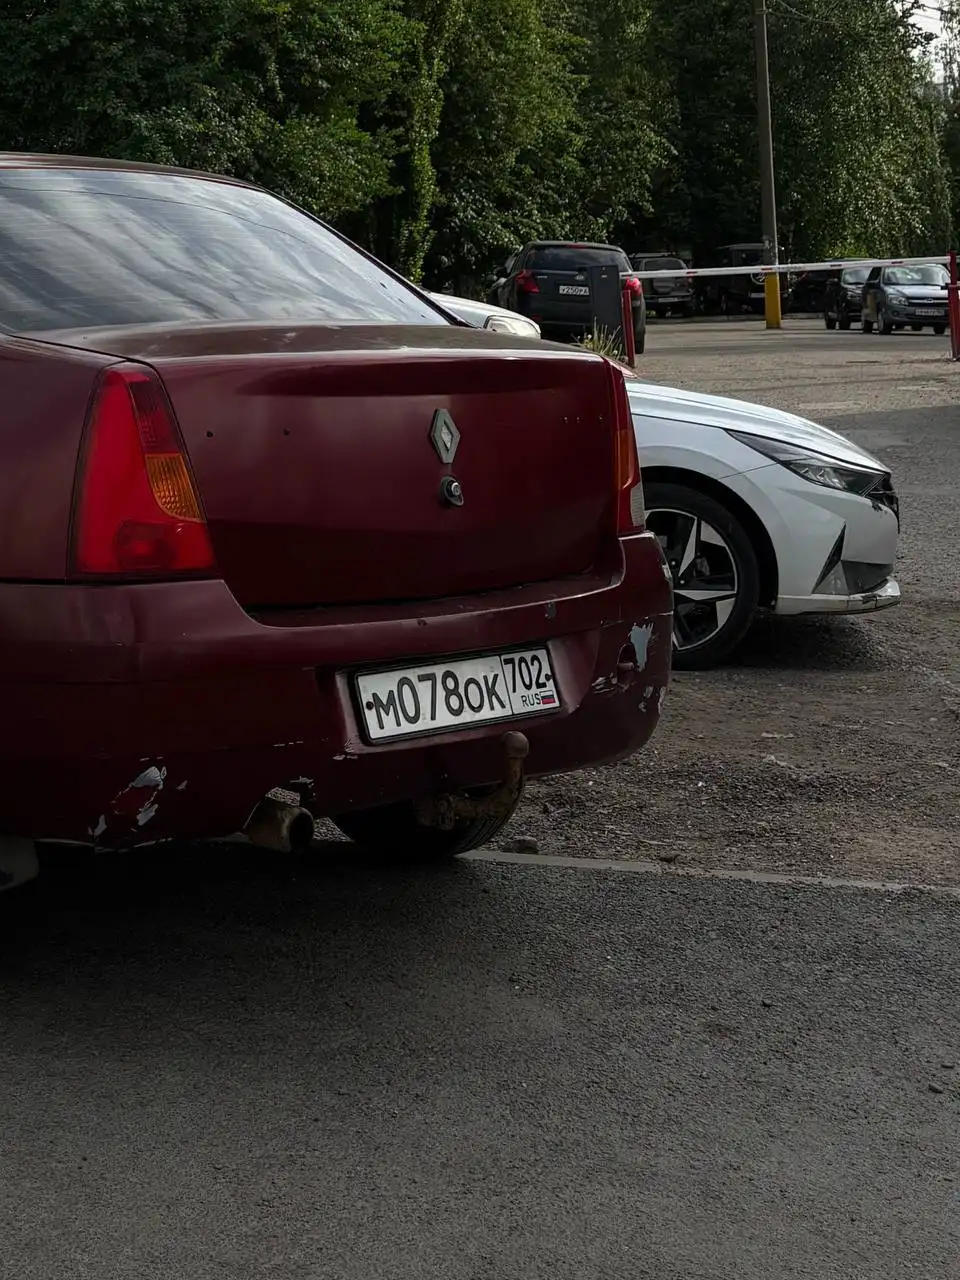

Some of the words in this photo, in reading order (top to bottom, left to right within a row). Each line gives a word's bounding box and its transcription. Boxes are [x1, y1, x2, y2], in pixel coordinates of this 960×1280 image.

[371, 670, 507, 730] М078ОК
[503, 654, 548, 694] 702
[521, 693, 541, 708] RUS
